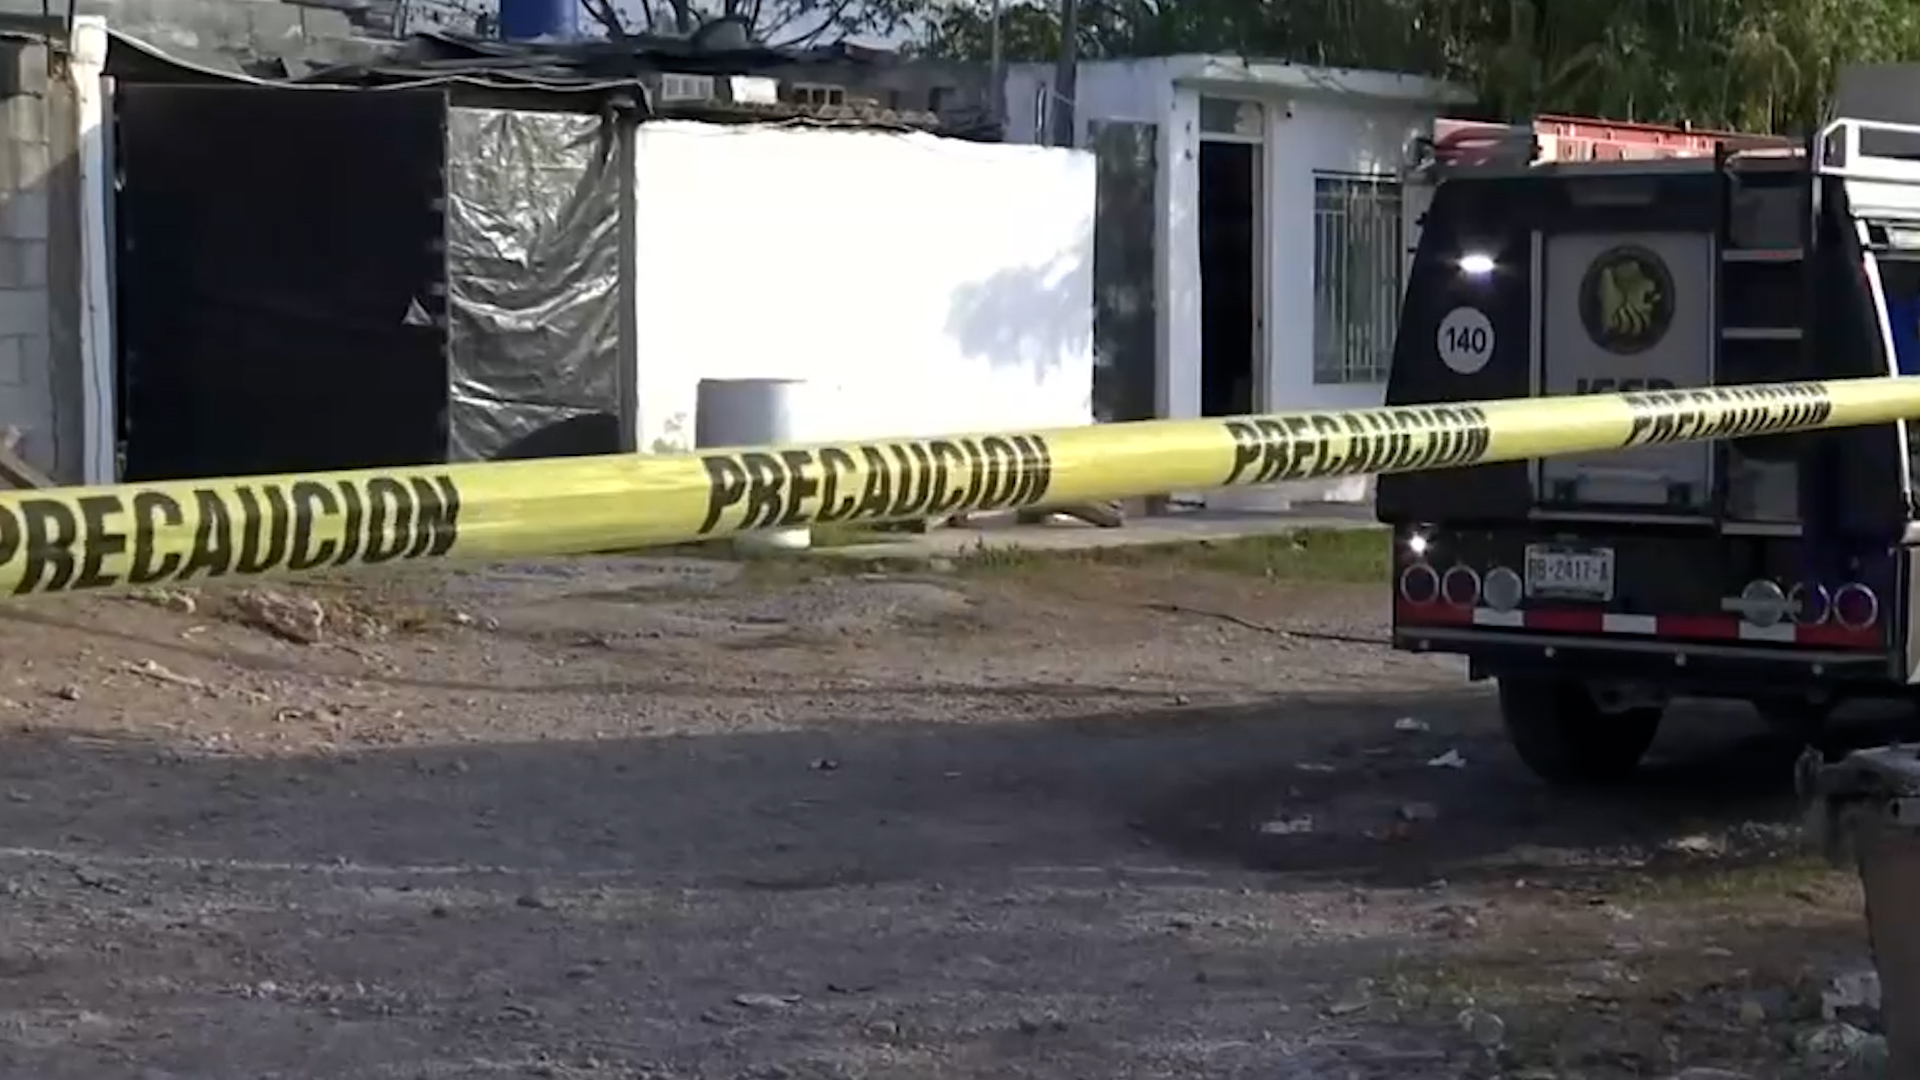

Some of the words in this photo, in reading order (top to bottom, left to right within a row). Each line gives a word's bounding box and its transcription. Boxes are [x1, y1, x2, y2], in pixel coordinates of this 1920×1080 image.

[1446, 326, 1487, 354] 140
[697, 434, 1051, 534] PRECAUCION
[1223, 407, 1490, 485] PRECAUCION
